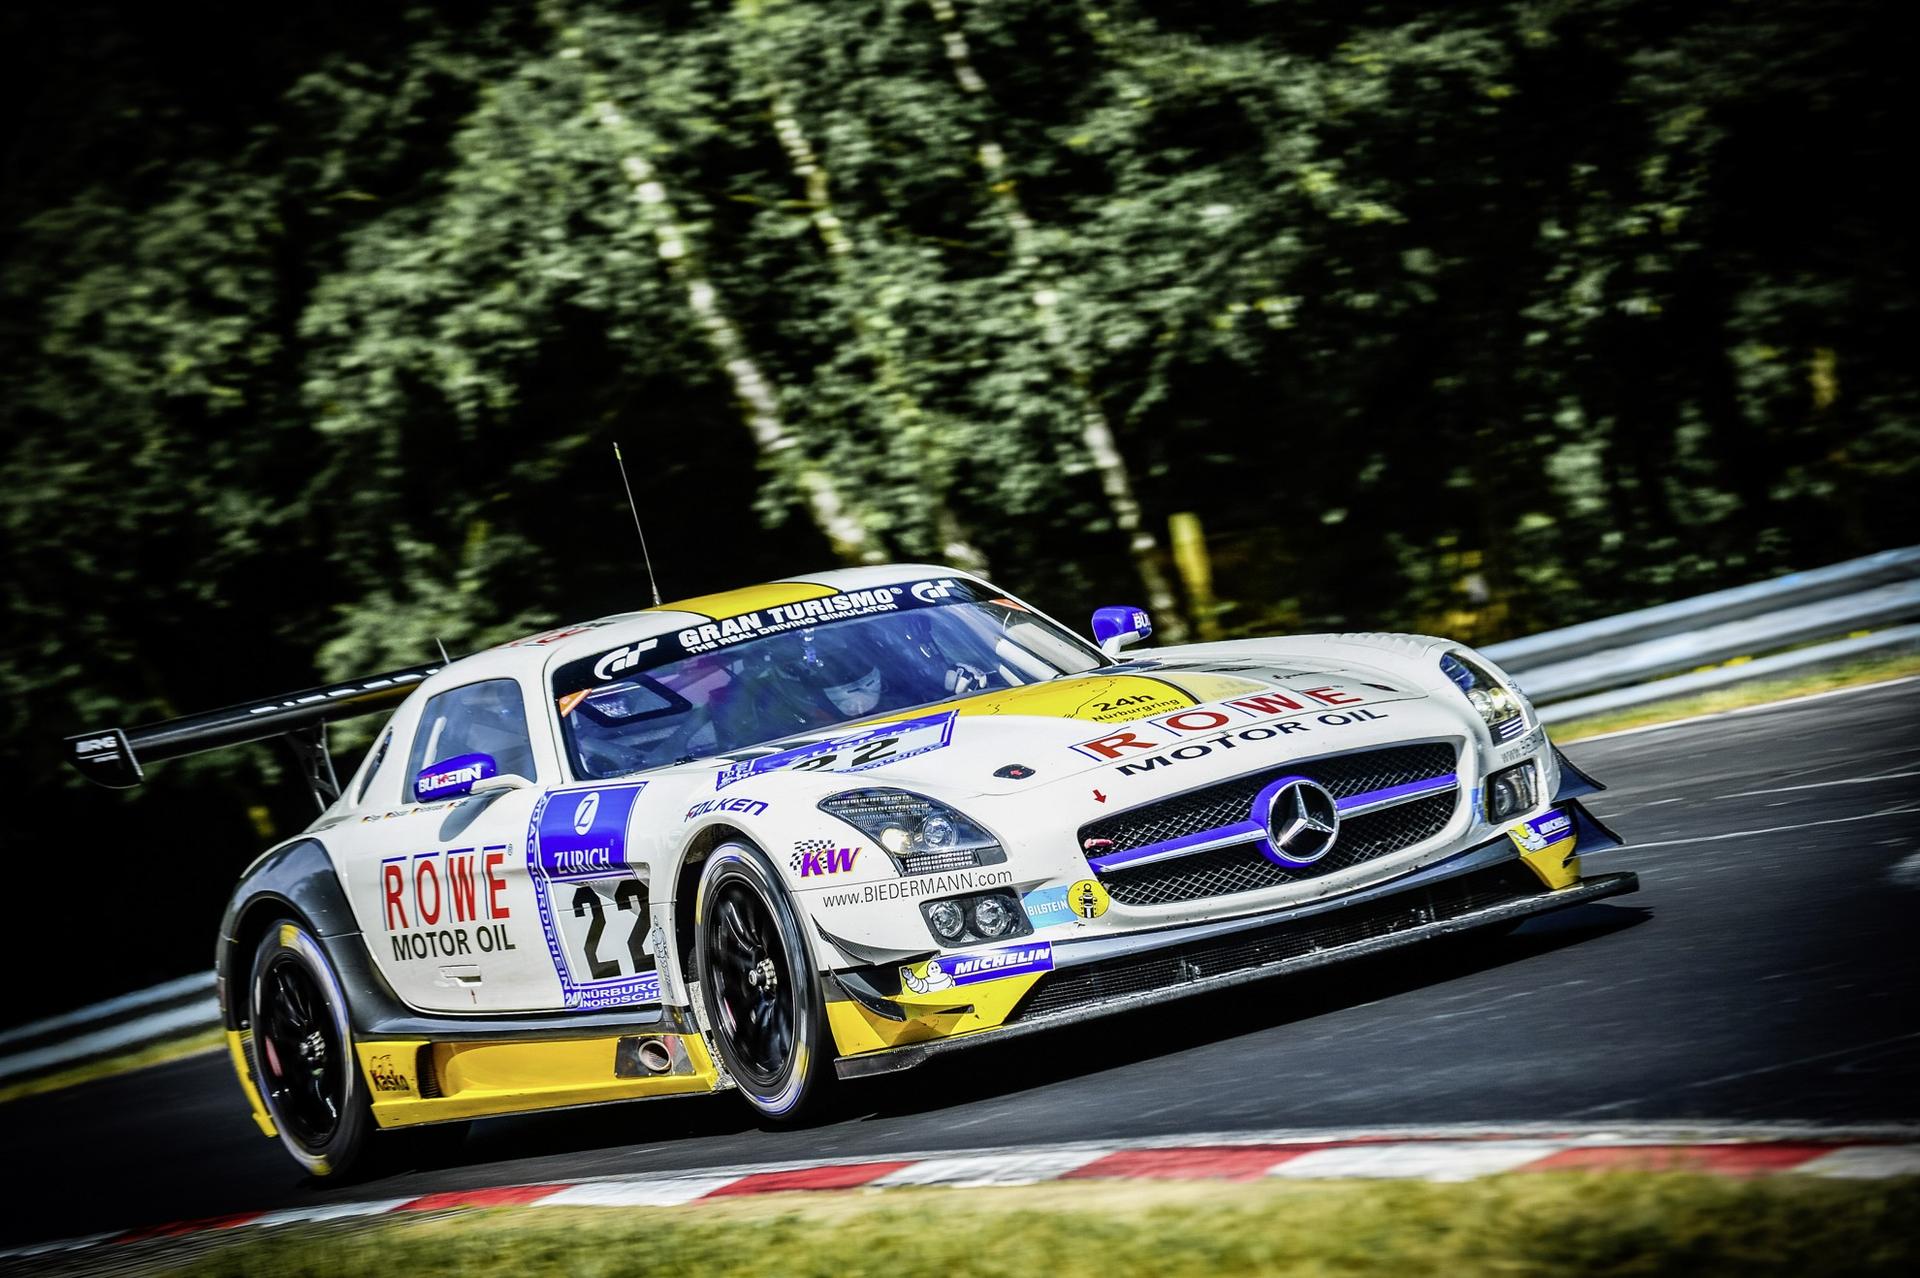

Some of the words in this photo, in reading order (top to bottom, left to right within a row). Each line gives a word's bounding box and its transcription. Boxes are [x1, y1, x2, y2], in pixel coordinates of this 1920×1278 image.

[678, 612, 763, 648] GRAN
[686, 641, 718, 655] THE
[720, 632, 757, 646] REAL
[760, 616, 817, 636] DRIVING
[821, 603, 898, 622] SIMULATOR
[1092, 695, 1156, 712] 24h
[1076, 687, 1363, 760] ROWE
[1116, 721, 1311, 777] MOTOR
[1317, 709, 1389, 726] OIL
[683, 798, 769, 822] FALKEN
[553, 847, 614, 875] ZURICH
[799, 846, 863, 878] KW
[382, 848, 512, 932] ROWE
[822, 869, 1013, 908] www.BIEDERMANN.com
[528, 863, 570, 990] NORDRHEIN
[1027, 900, 1069, 916] BILSTEIN
[391, 927, 471, 961] MOTOR
[476, 924, 516, 952] OIL
[572, 879, 656, 980] 22
[955, 947, 1051, 975] MICHELIN
